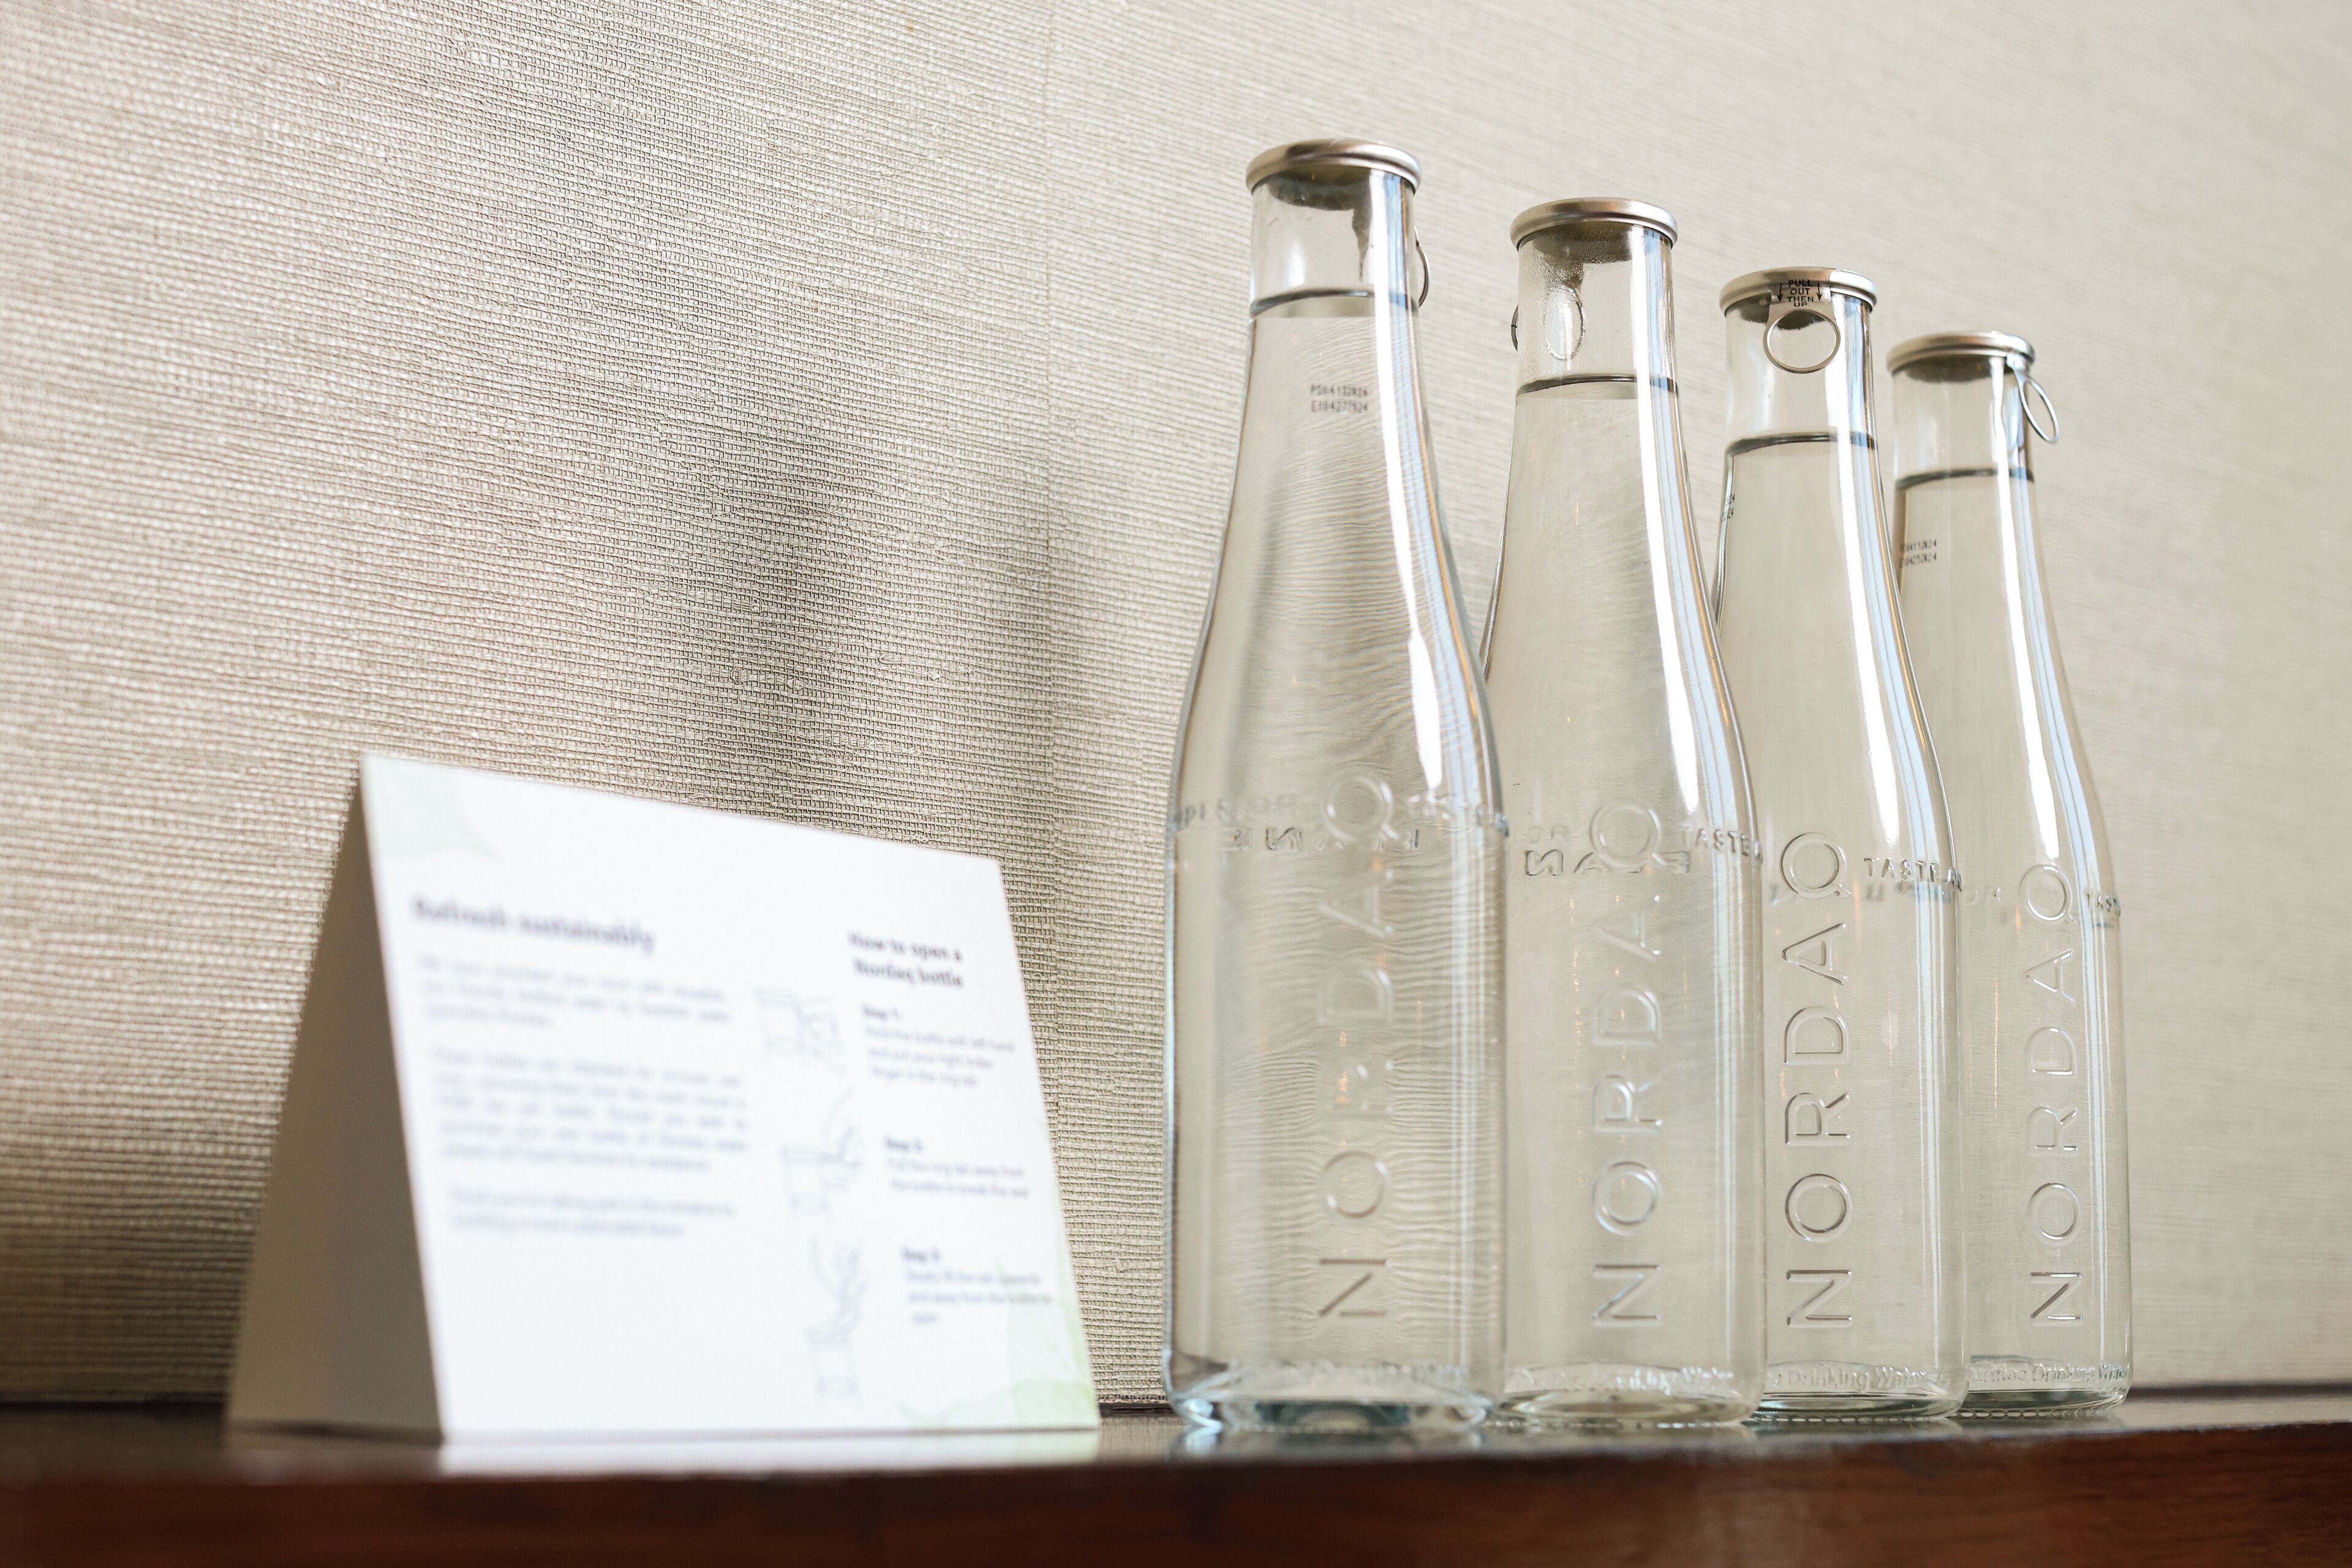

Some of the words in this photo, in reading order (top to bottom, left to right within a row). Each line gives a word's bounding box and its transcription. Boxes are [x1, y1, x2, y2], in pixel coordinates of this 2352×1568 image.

[849, 931, 886, 951] How
[890, 939, 906, 954] to
[911, 943, 949, 961] open
[918, 964, 965, 988] bottle
[1317, 774, 1399, 1318] NORDAQ
[1591, 802, 1665, 1327] NORDAQ
[1782, 832, 1852, 1327] NORDAQ
[2021, 864, 2082, 1327] NORDAQ
